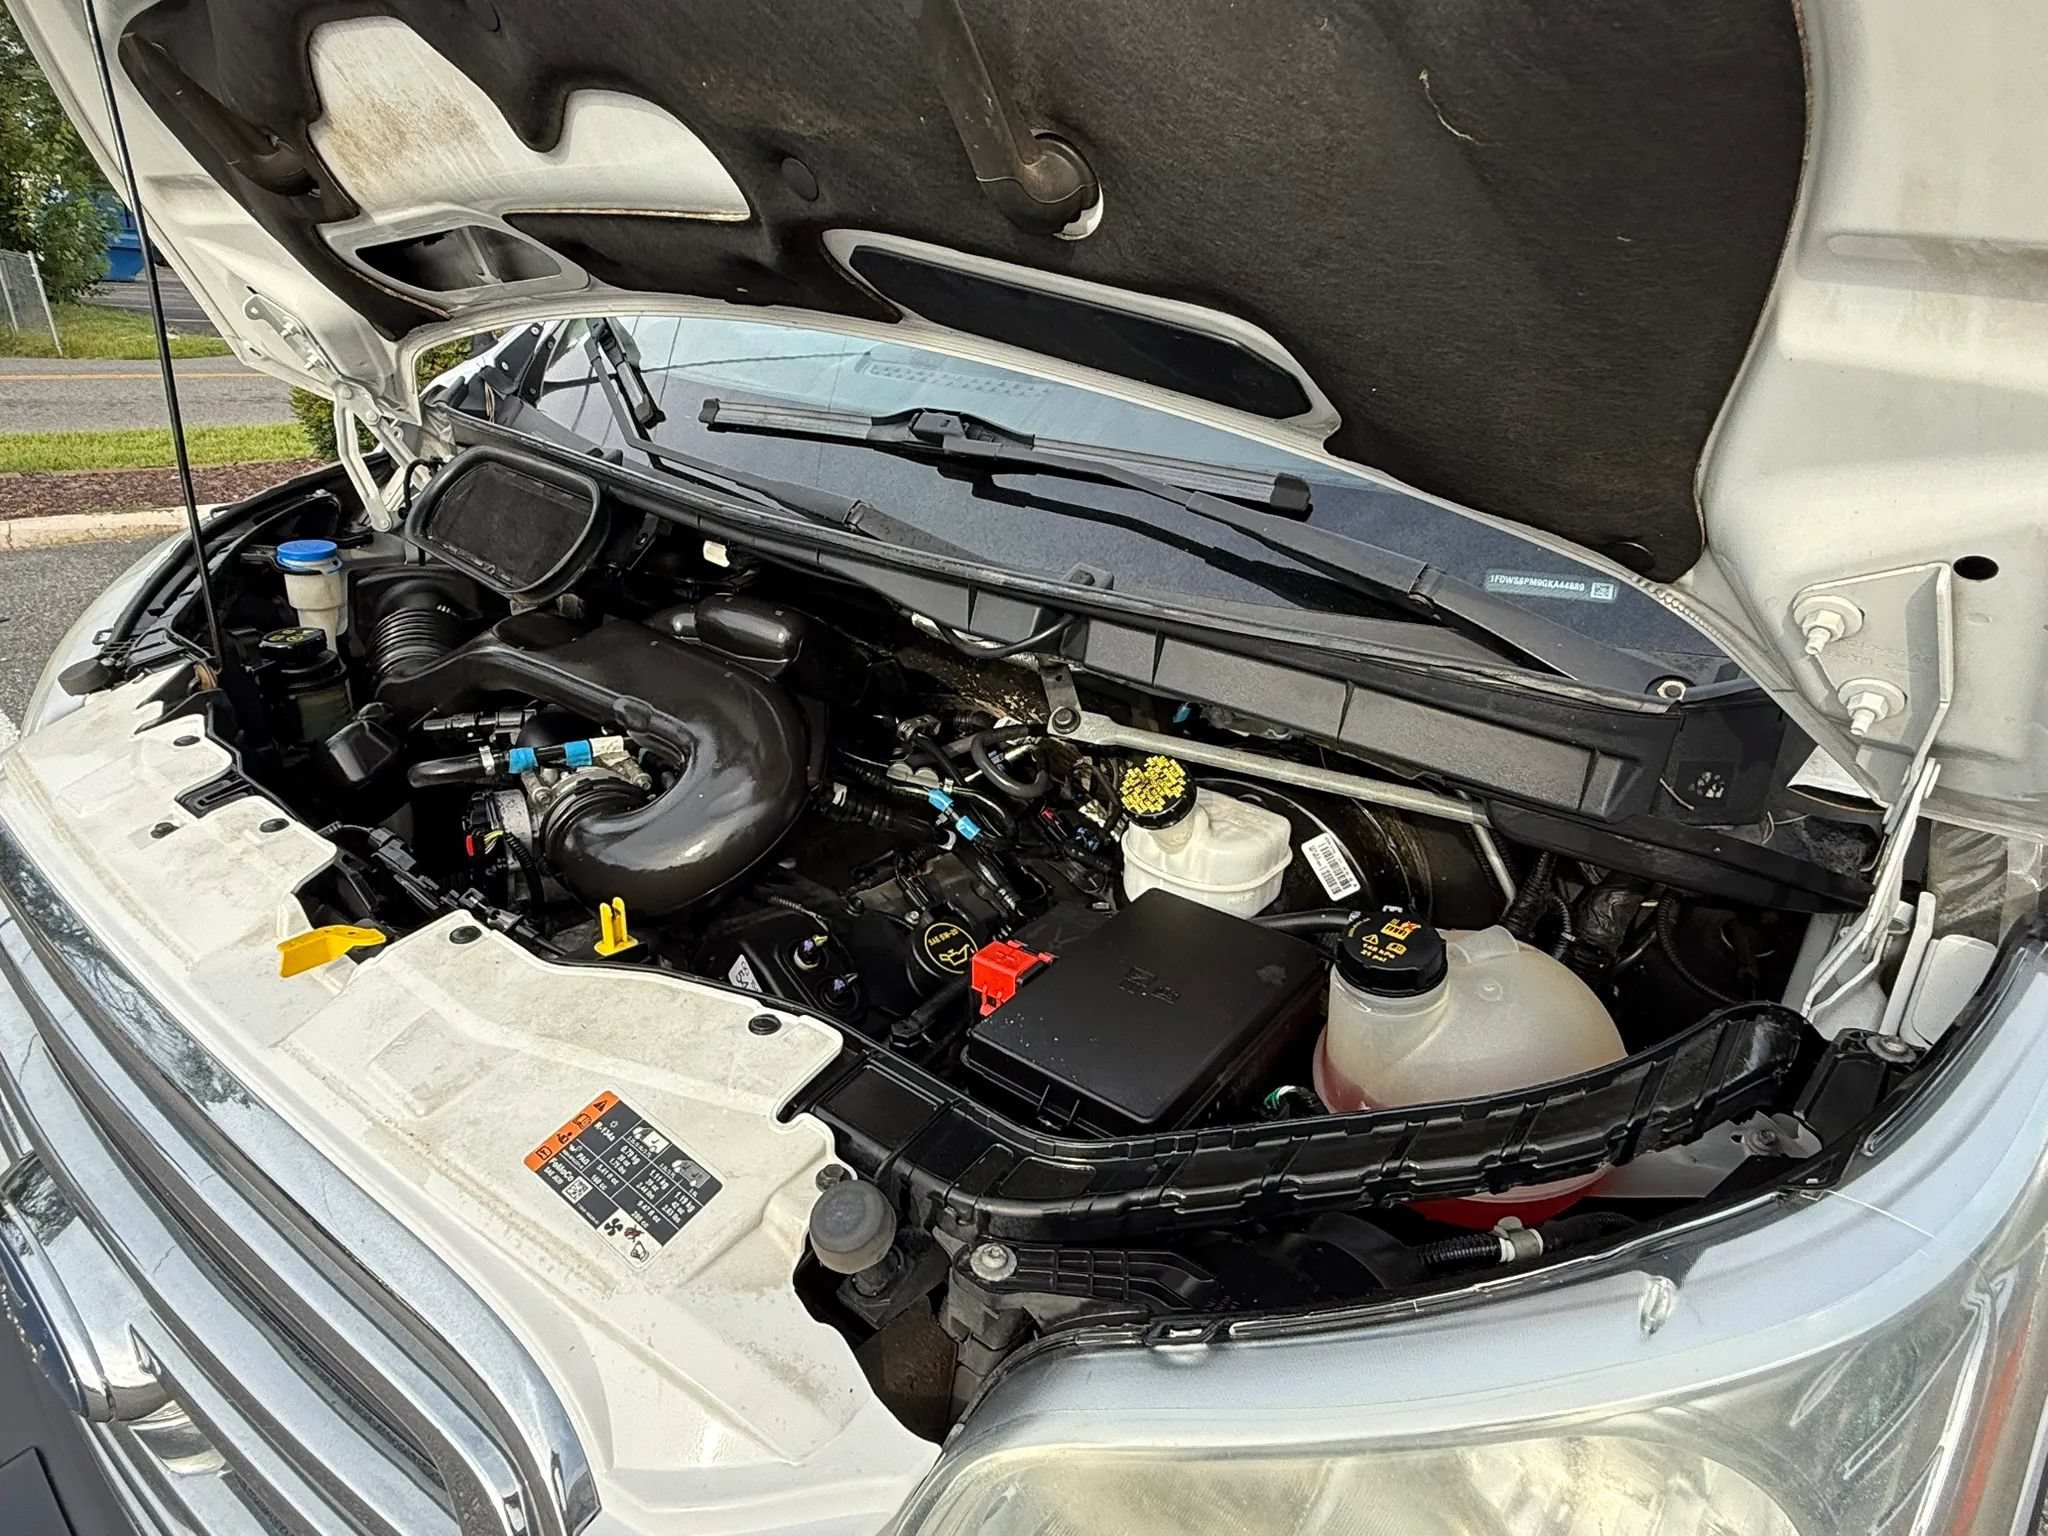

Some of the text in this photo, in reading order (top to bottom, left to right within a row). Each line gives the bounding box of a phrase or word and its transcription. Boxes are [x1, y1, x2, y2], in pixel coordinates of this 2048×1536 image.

[594, 1121, 615, 1141] R-134a
[576, 1152, 589, 1165] PAG
[620, 1145, 640, 1165] 0.79 kg
[543, 1166, 555, 1176] SAE
[549, 1157, 573, 1181] FoMoCo
[596, 1163, 609, 1175] 5.41
[610, 1177, 619, 1185] oz
[617, 1165, 626, 1174] lbs
[591, 1174, 607, 1190] 160 cc
[645, 1178, 653, 1186] 39
[649, 1169, 669, 1189] 1.11 kg
[635, 1181, 654, 1199] 2.44 lbs
[671, 1201, 684, 1214] 42 oz
[674, 1191, 695, 1212] 1.19 kg
[636, 1200, 650, 1211] 9.47
[652, 1214, 661, 1223] oz
[661, 1204, 680, 1223] 2.63 lbs
[640, 1220, 649, 1228] cc
